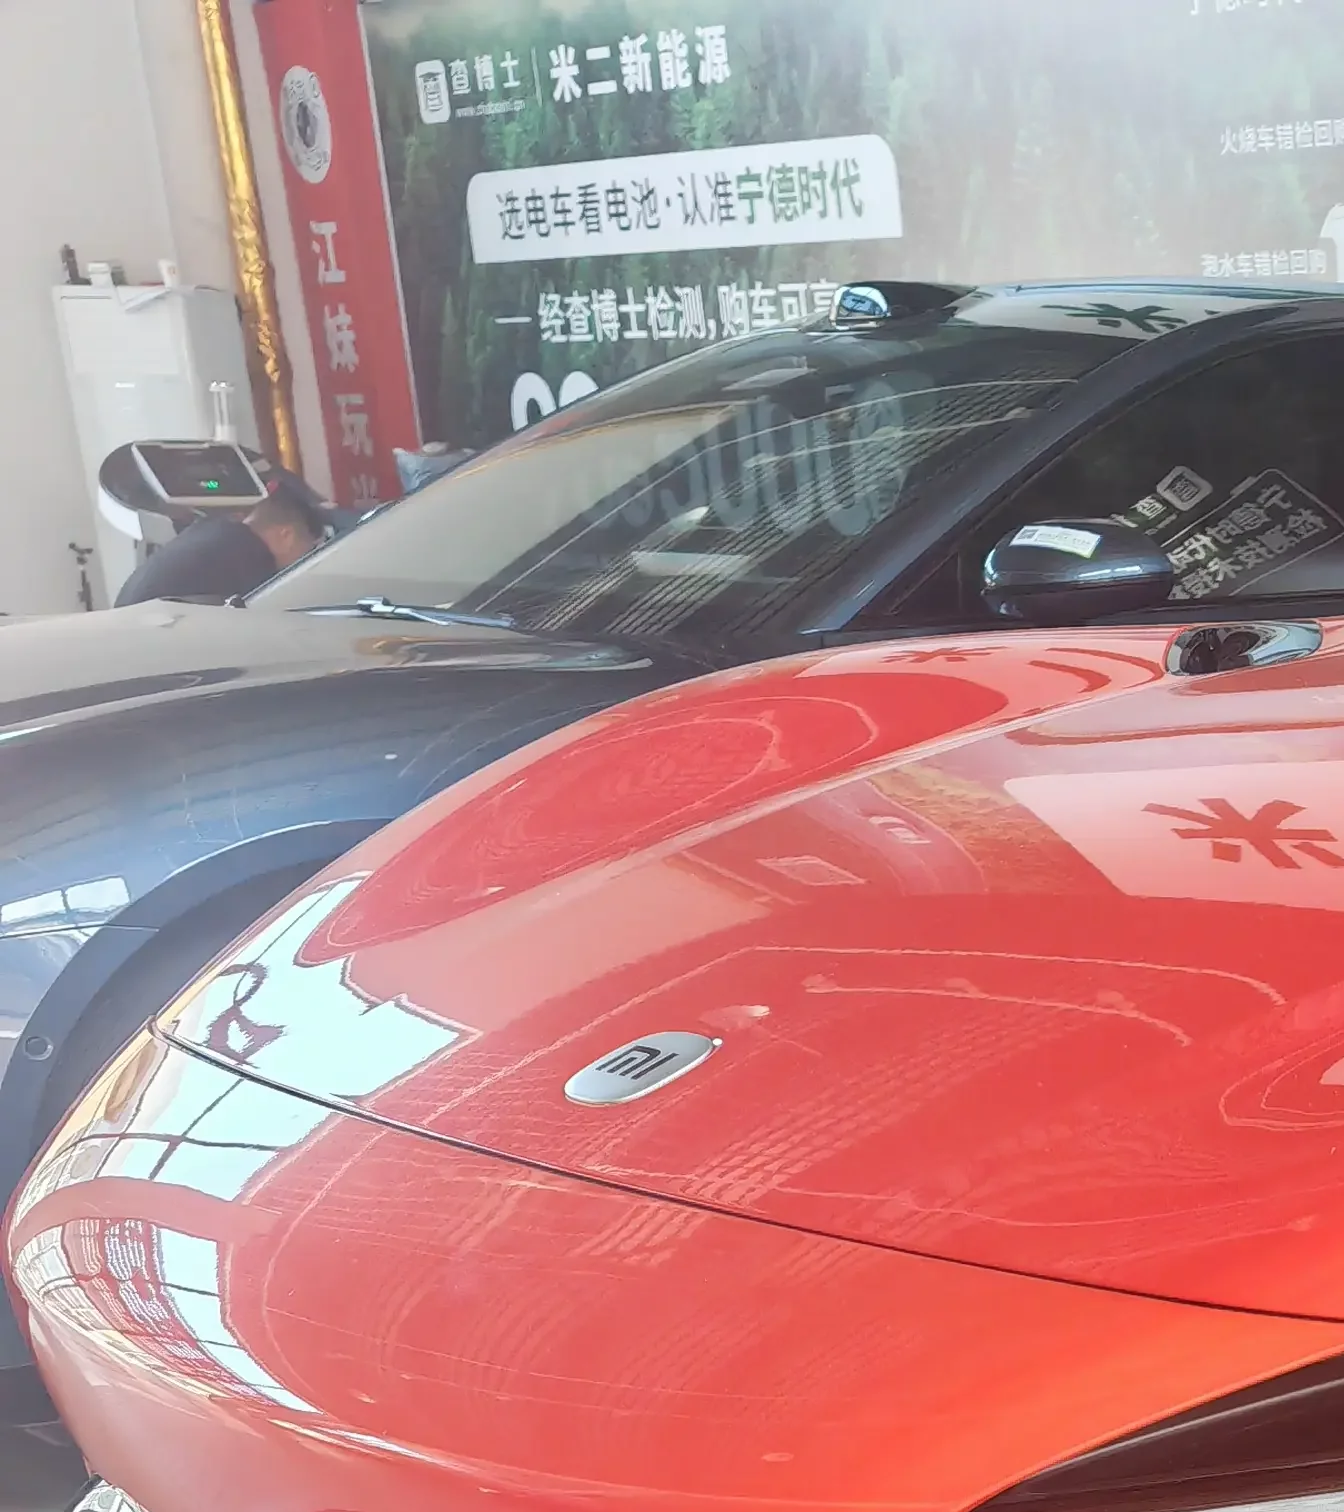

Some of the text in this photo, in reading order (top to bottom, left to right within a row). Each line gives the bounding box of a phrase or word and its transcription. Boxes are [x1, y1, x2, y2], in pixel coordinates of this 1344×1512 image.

[448, 51, 521, 95] 查博士
[549, 24, 732, 103] 米二新能源
